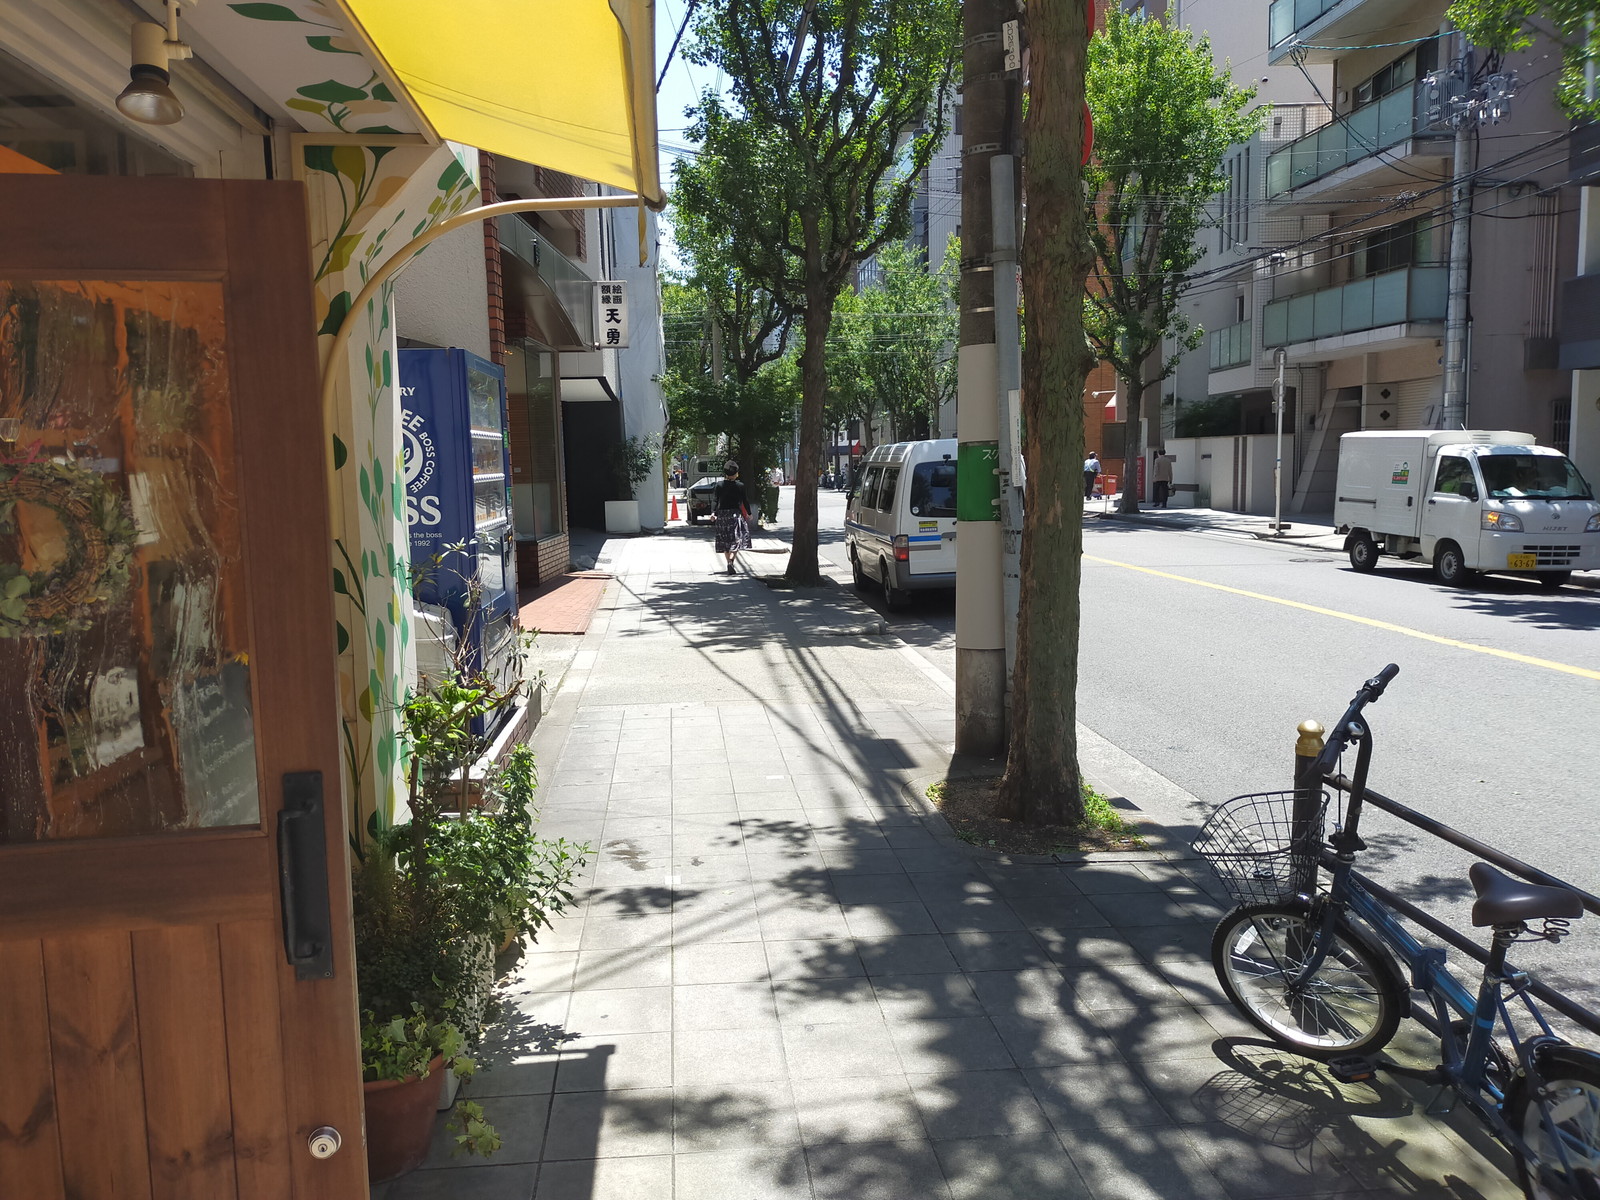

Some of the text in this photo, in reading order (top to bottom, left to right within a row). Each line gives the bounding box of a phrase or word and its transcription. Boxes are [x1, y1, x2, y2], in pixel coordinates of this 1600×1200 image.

[605, 308, 622, 345] 天勇
[400, 387, 416, 397] RY
[401, 409, 425, 432] EE
[410, 432, 436, 494] BOSS COFFEE
[406, 495, 442, 526] SS
